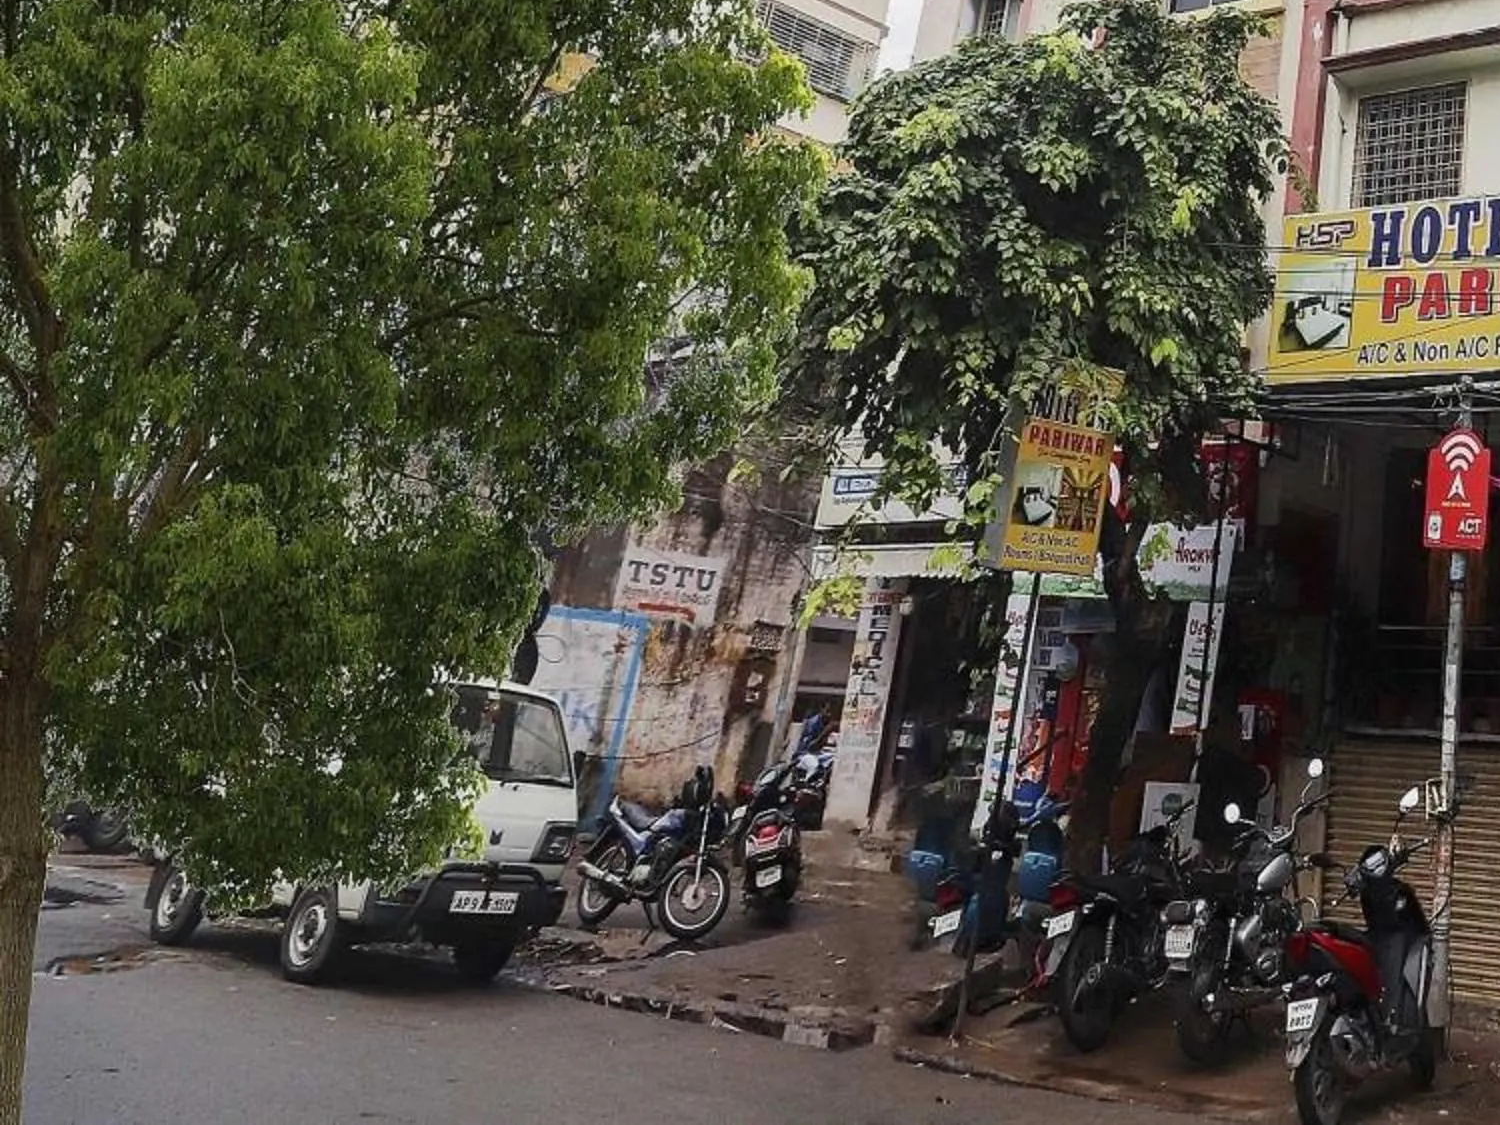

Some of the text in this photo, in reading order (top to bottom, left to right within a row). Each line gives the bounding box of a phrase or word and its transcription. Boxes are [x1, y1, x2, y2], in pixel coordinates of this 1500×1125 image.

[1357, 342, 1390, 364] A/C
[1394, 344, 1407, 363] &
[1413, 341, 1449, 362] Non
[1456, 336, 1489, 359] A/C
[1029, 424, 1105, 455] PARIWAR
[1457, 518, 1482, 534] ACT
[628, 560, 717, 592] TSTU
